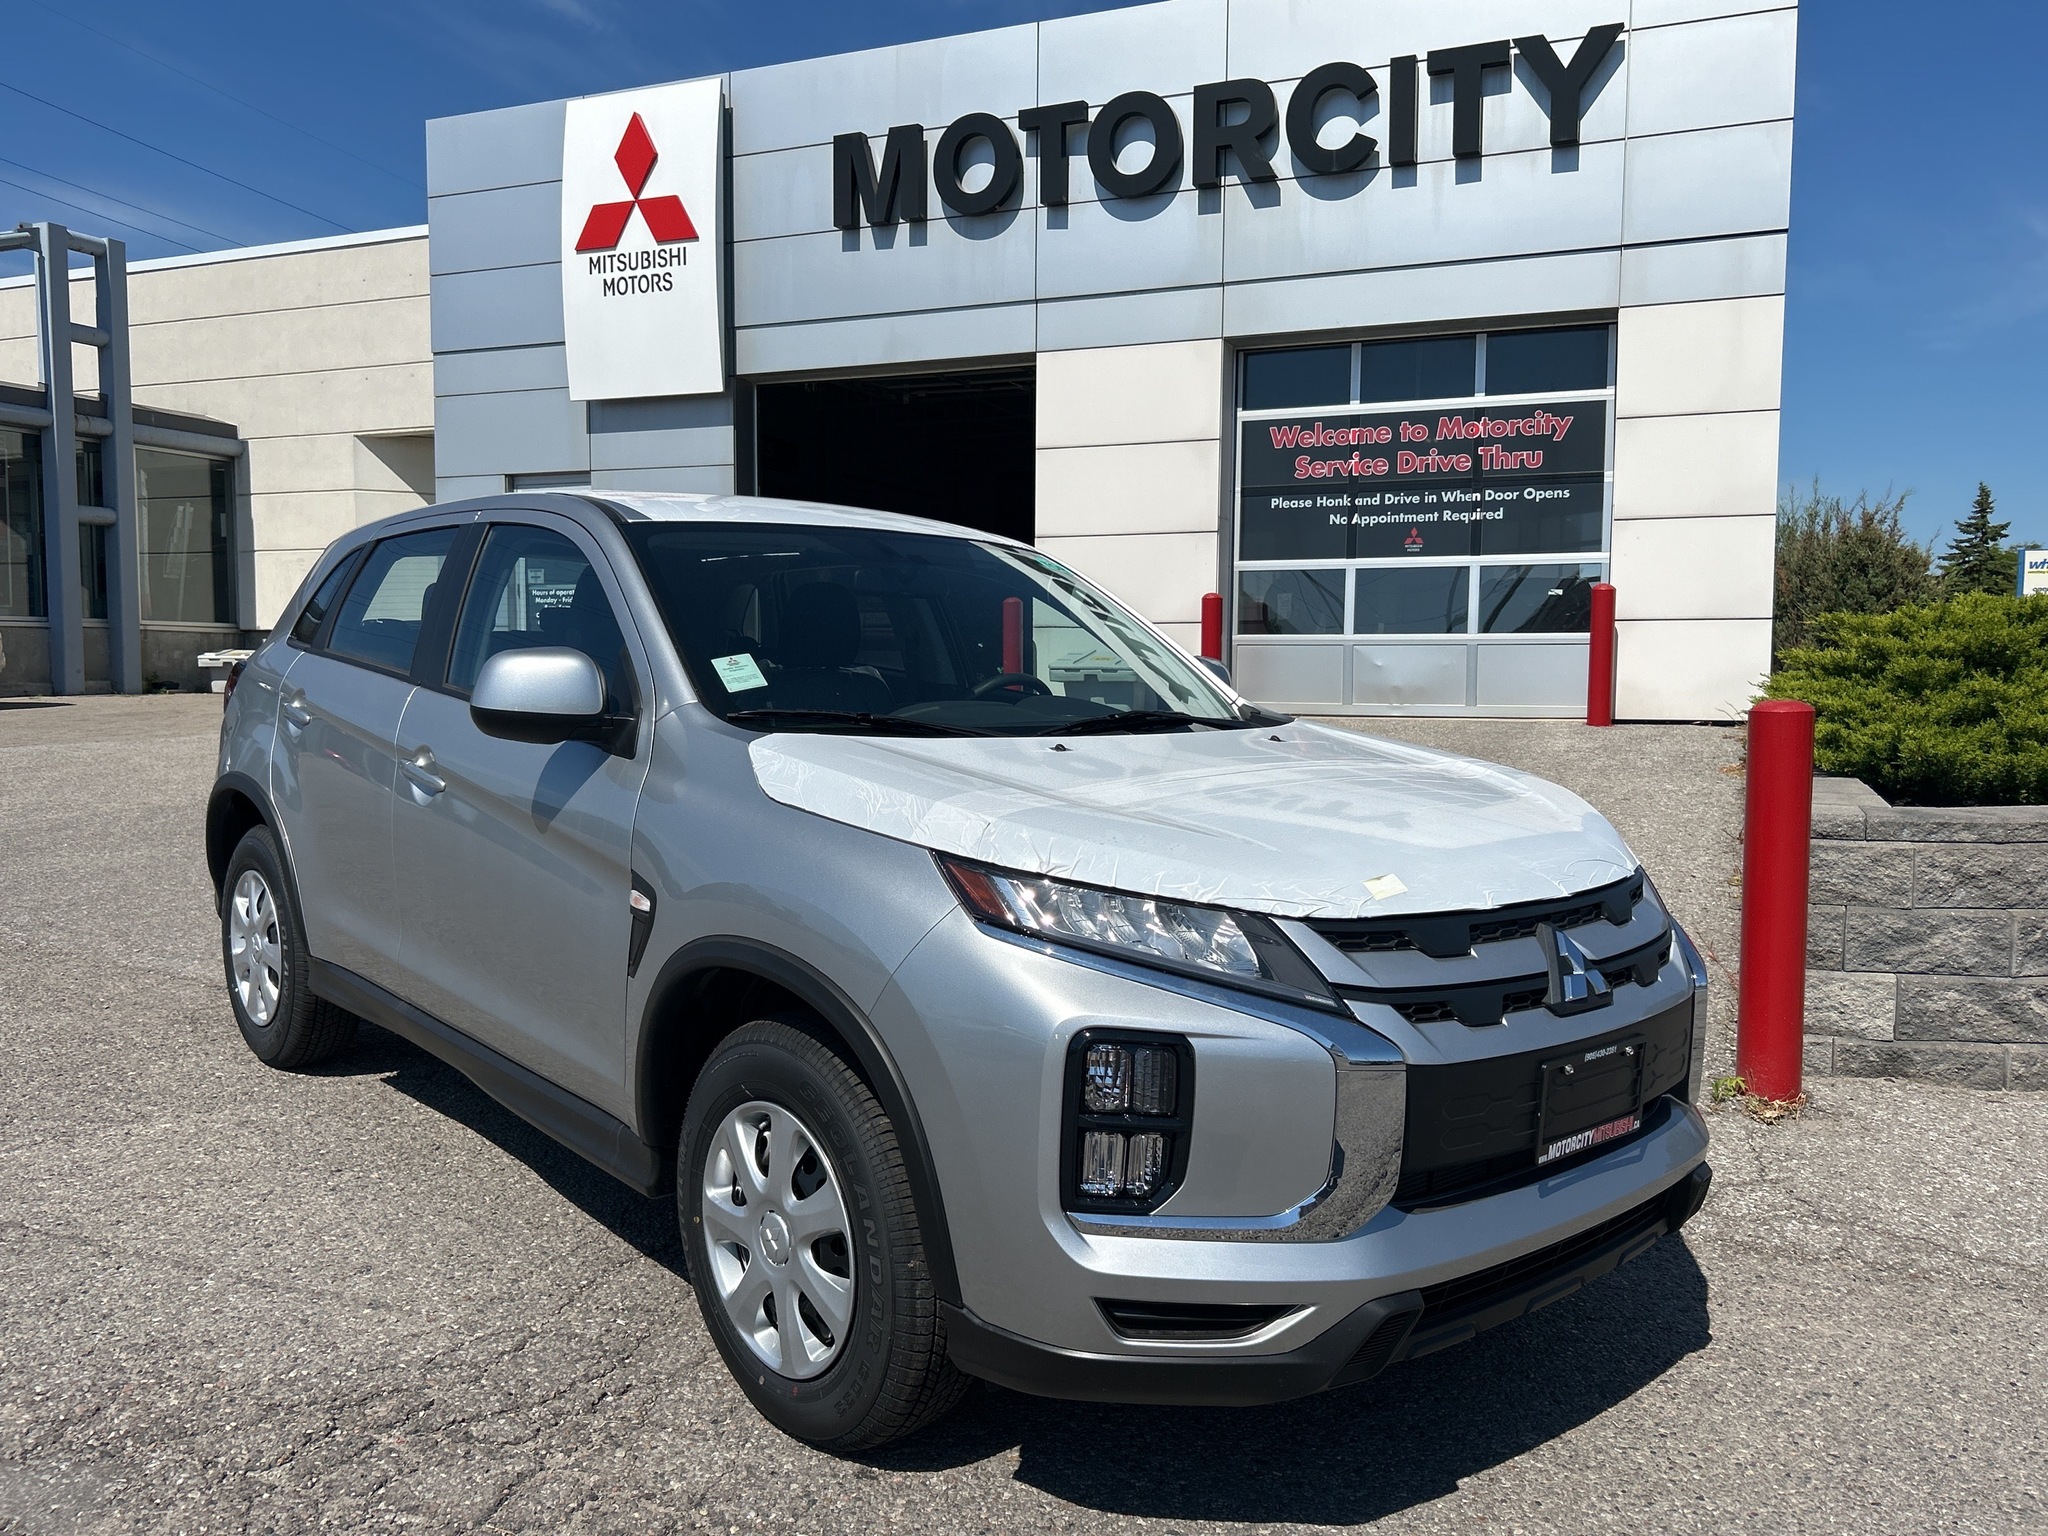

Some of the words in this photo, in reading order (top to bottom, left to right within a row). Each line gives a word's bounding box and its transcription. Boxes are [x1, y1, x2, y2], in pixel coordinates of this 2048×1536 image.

[833, 22, 1625, 230] MOTORCITY
[589, 246, 687, 275] MITSUBISHI
[602, 271, 673, 297] MOTORS
[1269, 421, 1392, 449] Welcome
[1399, 421, 1429, 442] to
[1436, 409, 1574, 441] Motorcity
[1294, 451, 1389, 479] Service
[1397, 448, 1472, 474] Drive
[1478, 444, 1543, 470] Thru
[1271, 497, 1312, 509] Please
[1316, 494, 1352, 507] Honk
[1354, 493, 1380, 506] and
[1384, 492, 1420, 505] Drive
[1424, 491, 1437, 503] in
[1441, 489, 1481, 502] When
[1484, 489, 1520, 501] Door
[1523, 487, 1571, 502] Opens
[1329, 513, 1348, 525] No
[1351, 511, 1439, 527] Appointment
[1442, 507, 1504, 524] Required
[798, 1079, 884, 1356] GEOLANDAR
